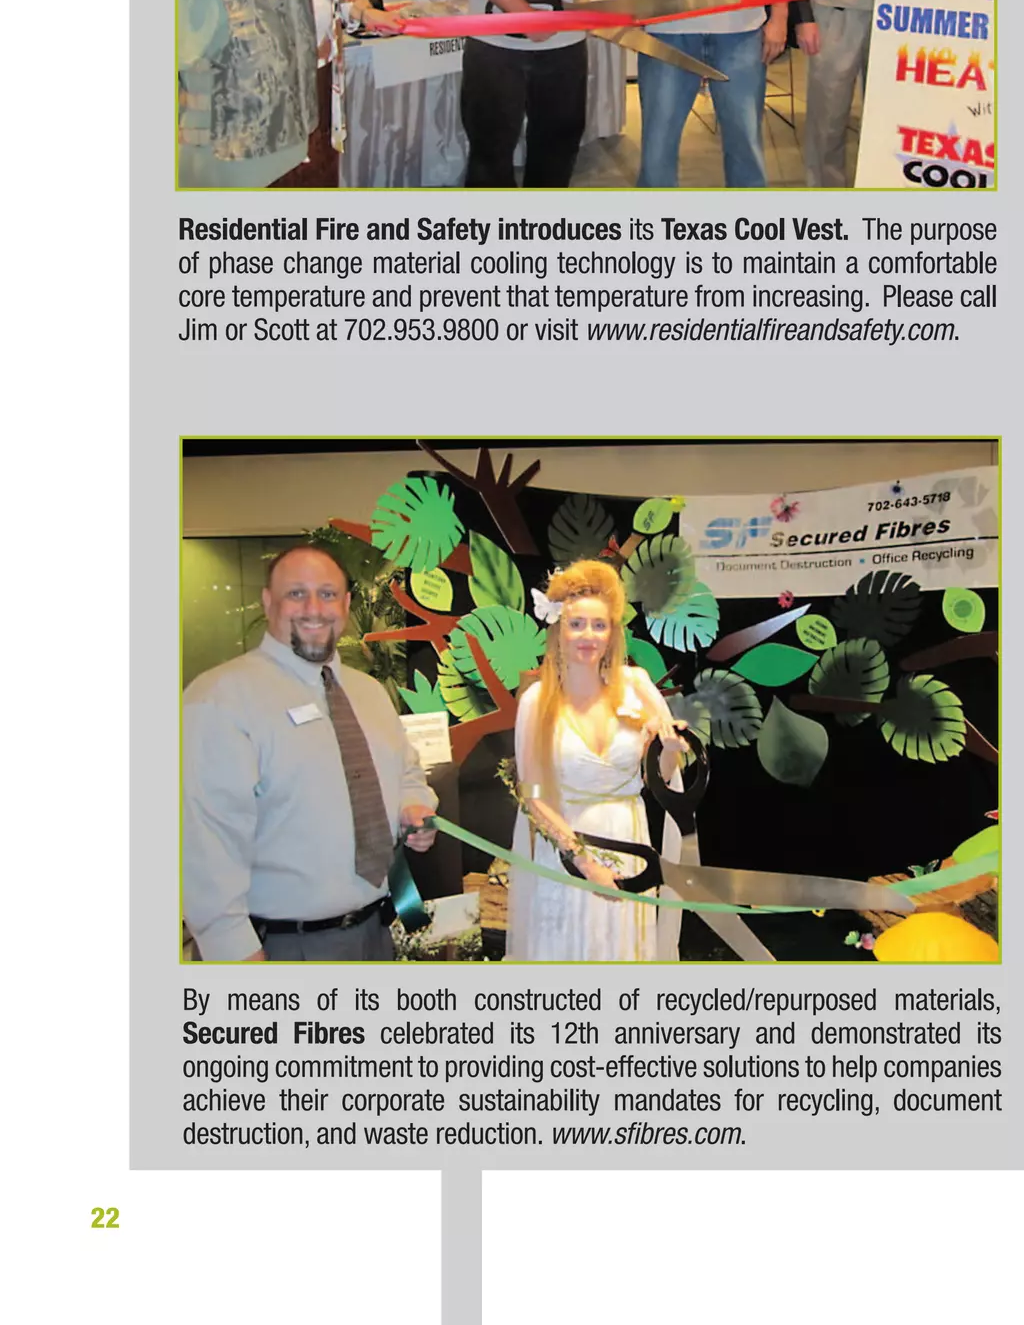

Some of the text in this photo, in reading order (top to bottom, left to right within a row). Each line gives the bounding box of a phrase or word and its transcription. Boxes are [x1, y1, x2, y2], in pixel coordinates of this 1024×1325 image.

[876, 3, 990, 40] SUMMER
[429, 38, 465, 56] RESIDENT
[895, 42, 994, 91] HEA
[967, 102, 993, 117] Wit
[179, 318, 959, 346] Jim or Scott at 702.953.9800 or visit www.residentialfireandsafety.com.
[866, 491, 951, 513] 702-643-5718
[769, 518, 951, 549] Secured Fibres
[715, 546, 975, 573] Document Destruction Office Recycling
[183, 1122, 745, 1148] destruction, and waste reduction. www.sfibres.com.
[91, 1207, 120, 1228] 22
